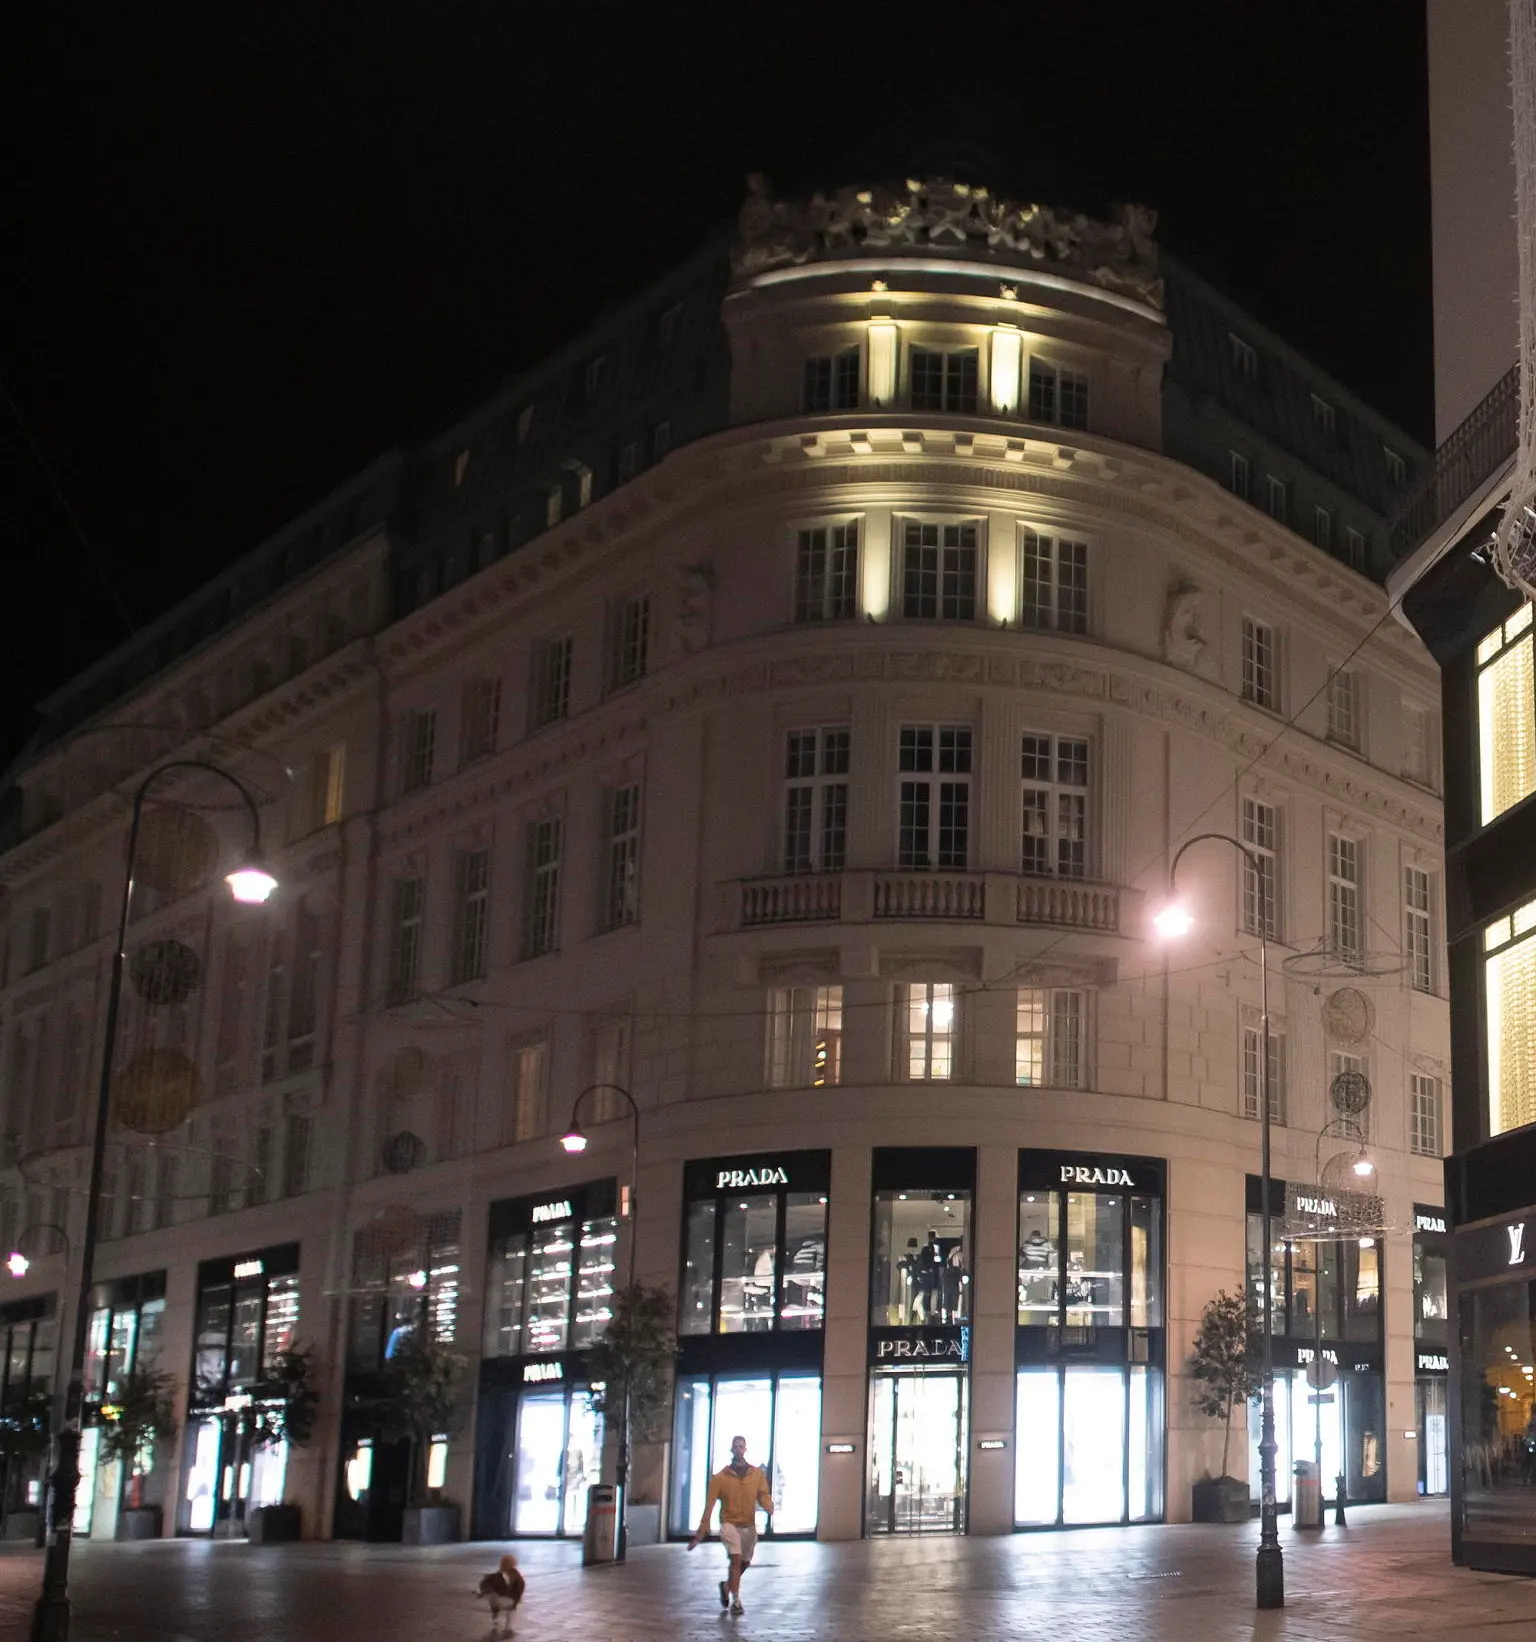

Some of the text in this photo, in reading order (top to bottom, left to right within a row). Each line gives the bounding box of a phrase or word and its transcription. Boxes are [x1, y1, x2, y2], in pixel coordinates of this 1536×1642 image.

[716, 1166, 789, 1190] PRADA
[1060, 1165, 1136, 1188] PRADA
[1296, 1196, 1338, 1217] PRADA
[1416, 1215, 1447, 1233] PRAD
[1507, 1222, 1526, 1266] LV
[877, 1339, 963, 1358] PRADA
[1297, 1347, 1339, 1365] PRDA
[1418, 1354, 1450, 1371] PRAD
